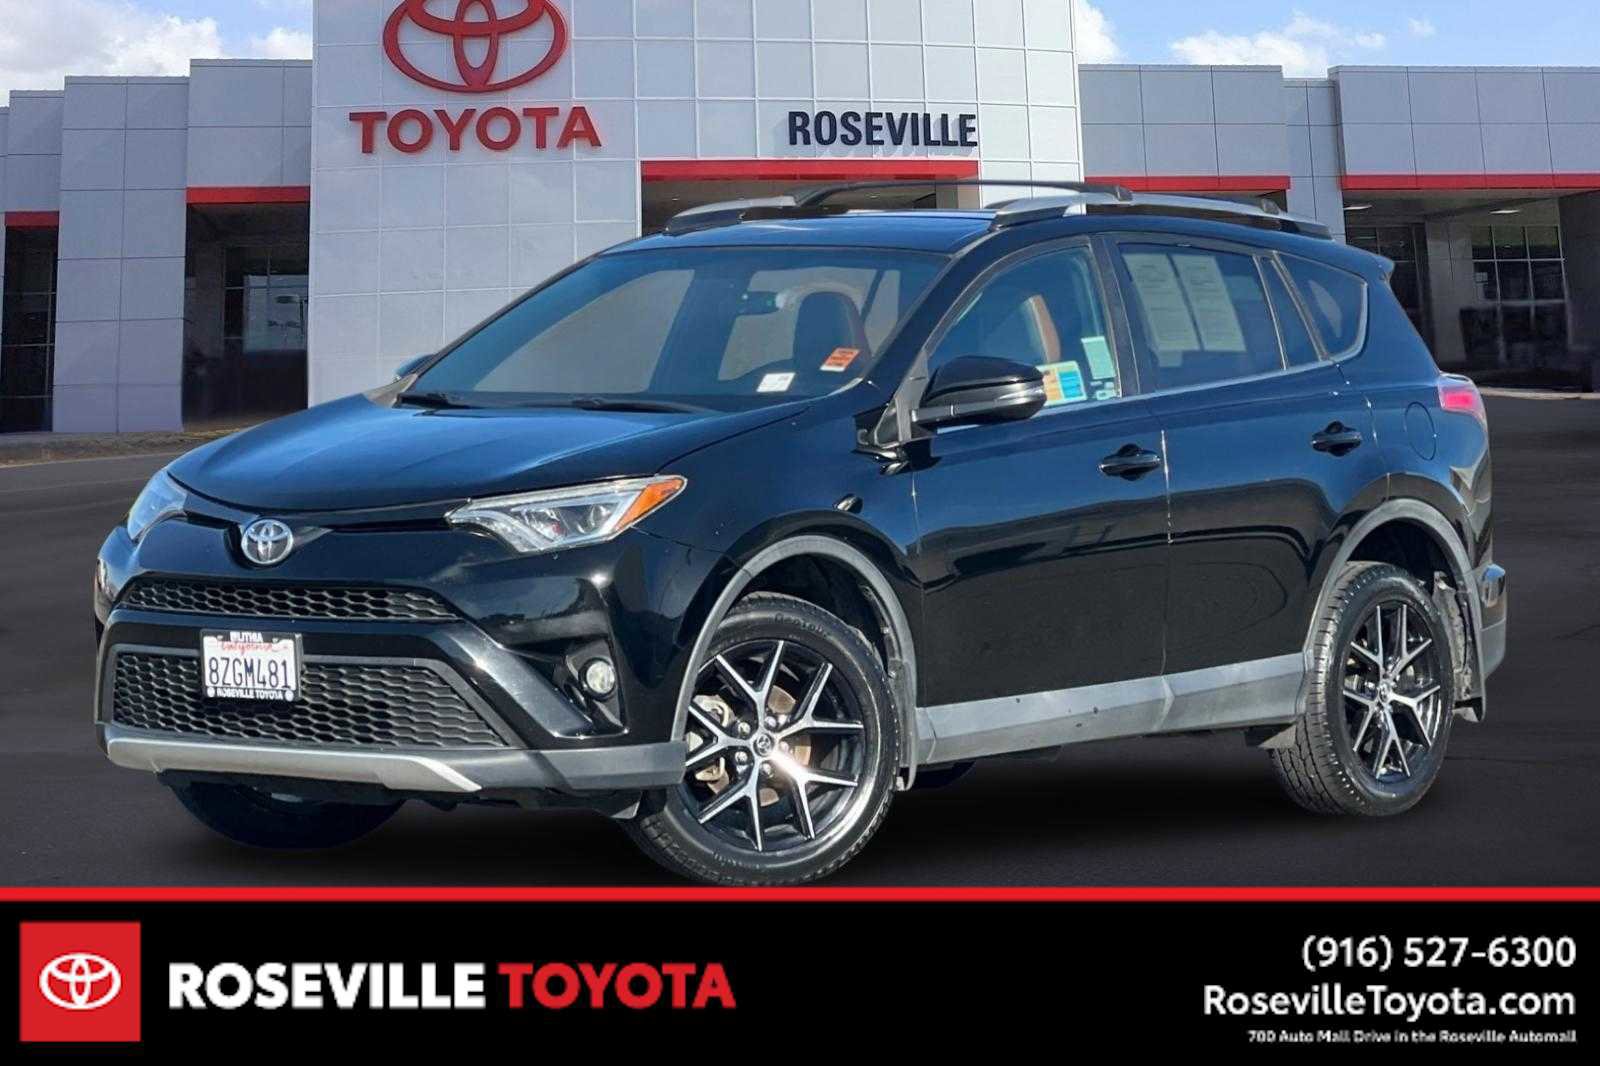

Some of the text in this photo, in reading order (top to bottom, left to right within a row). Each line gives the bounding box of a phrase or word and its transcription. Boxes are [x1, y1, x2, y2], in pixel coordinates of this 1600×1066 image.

[349, 107, 602, 154] TOYOTA
[788, 111, 978, 146] ROSEVILLE
[209, 657, 291, 688] 8ZGM481
